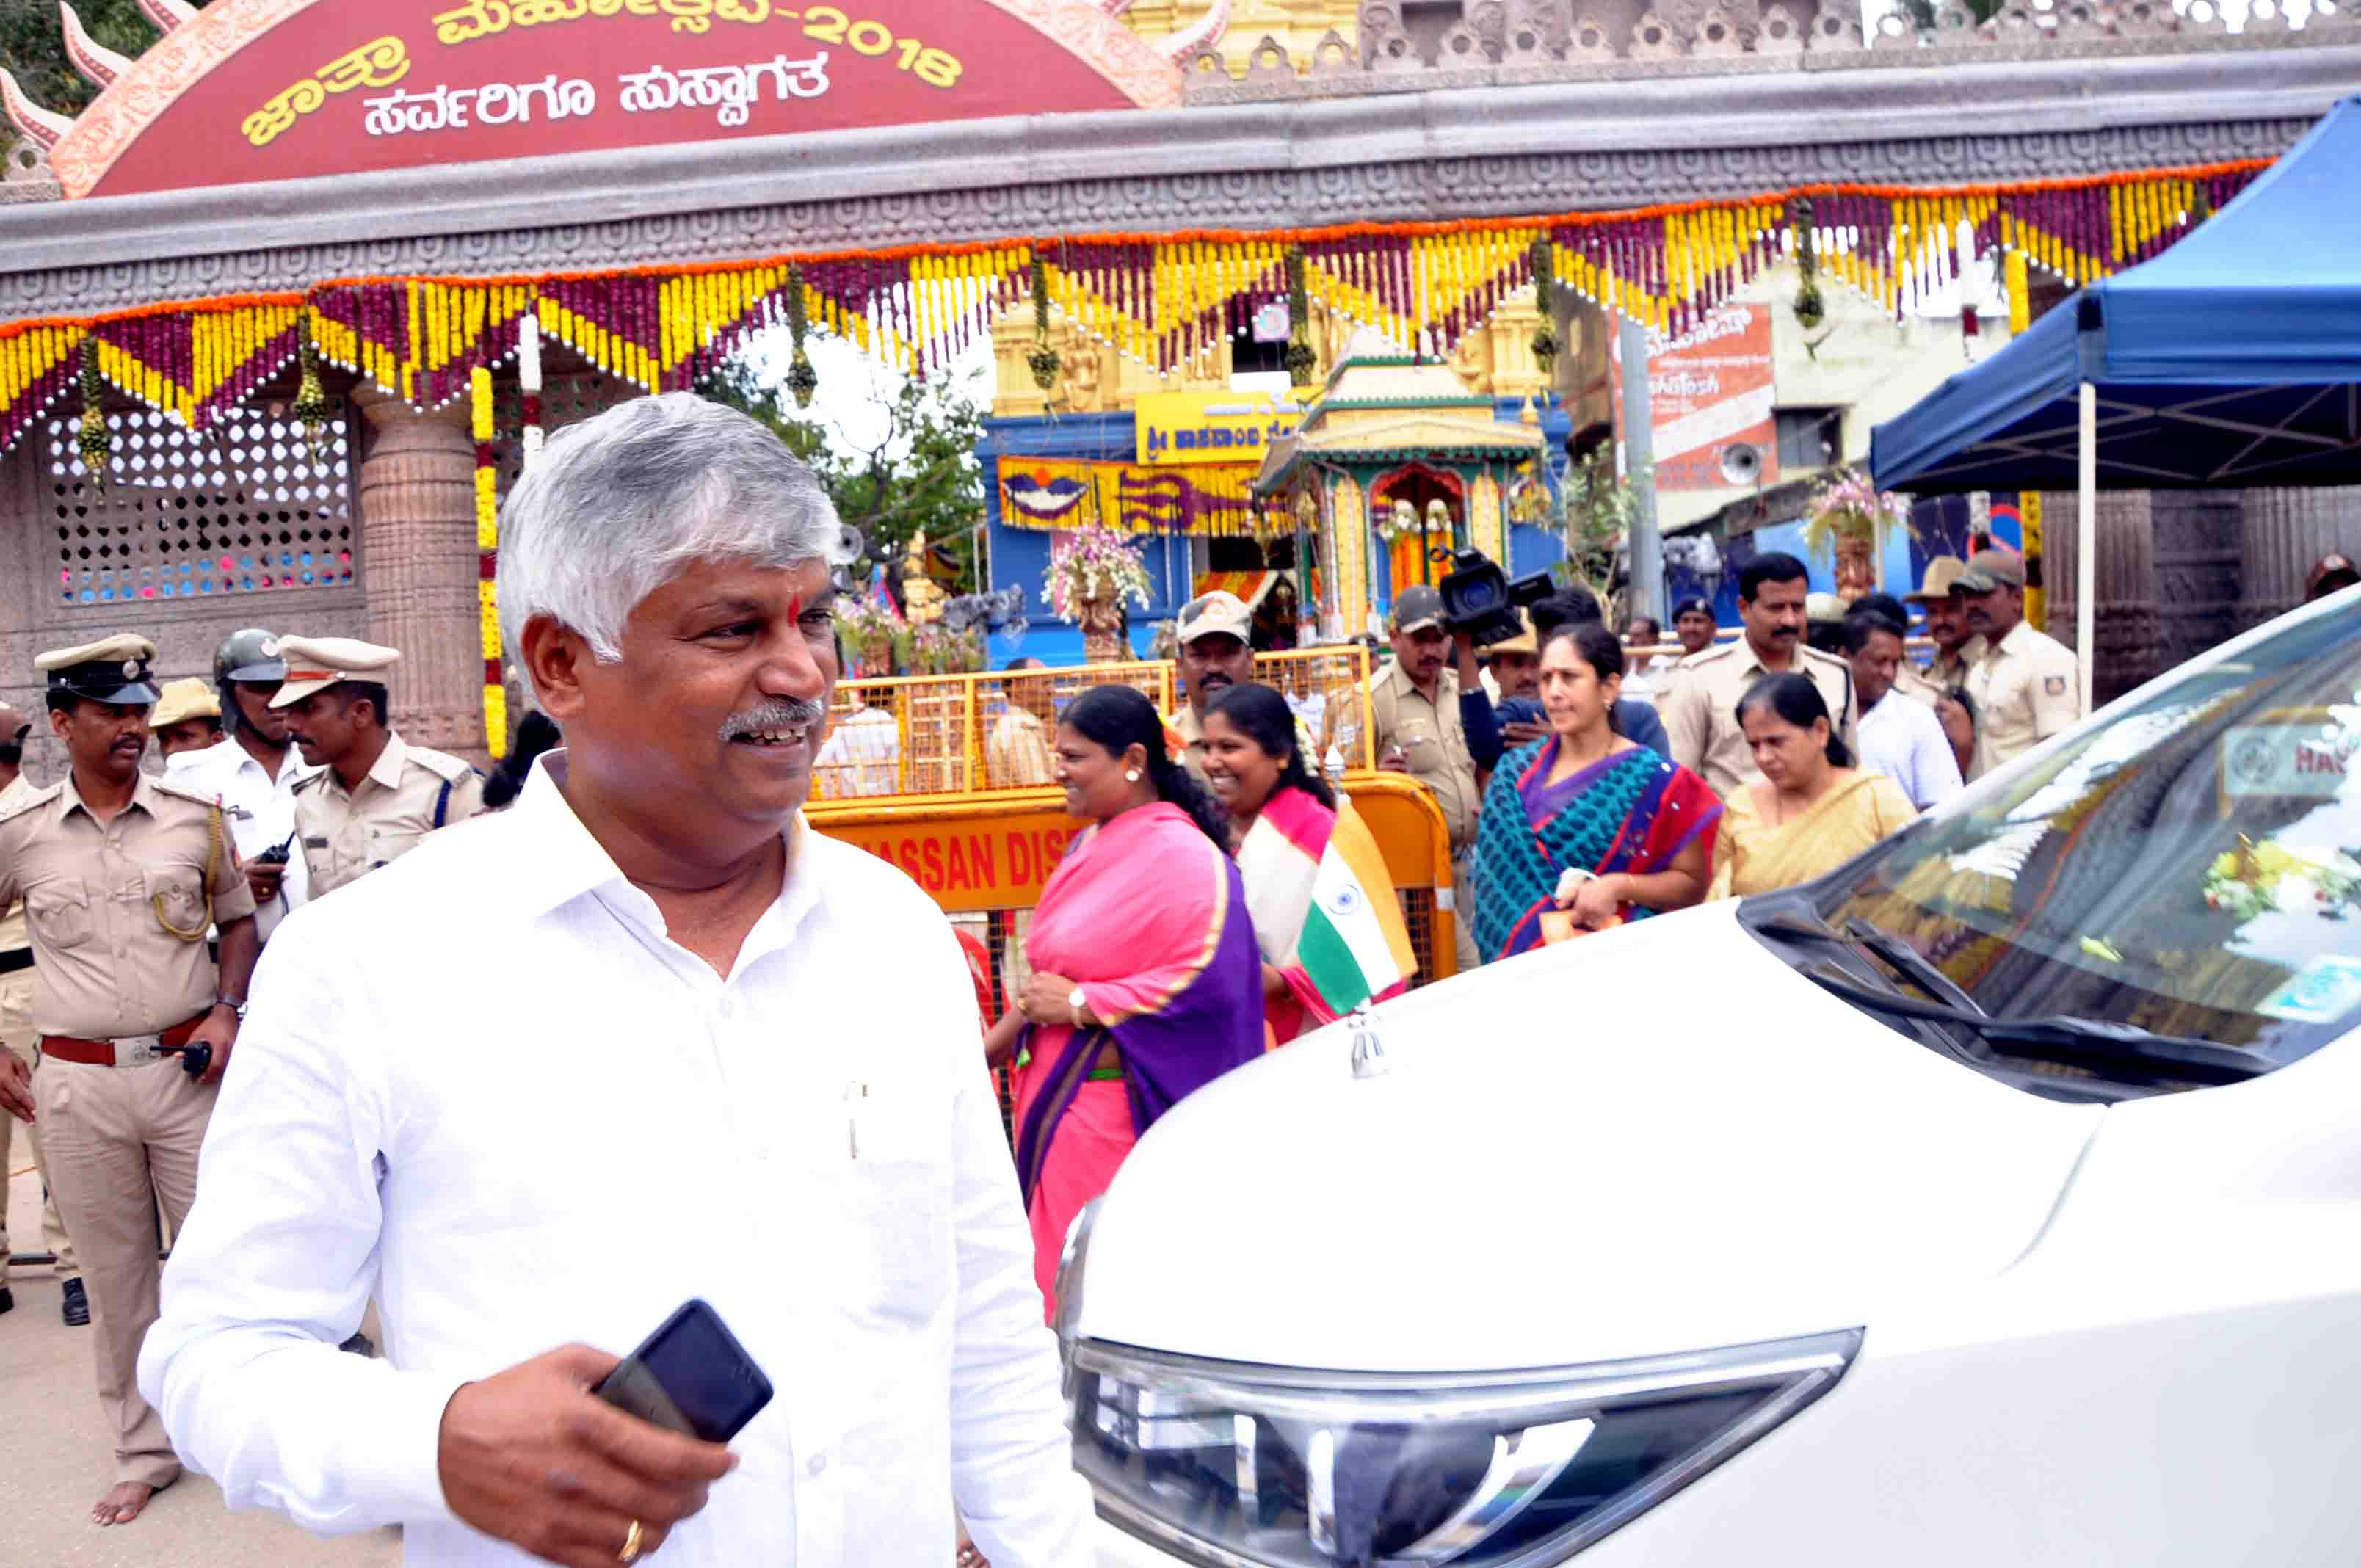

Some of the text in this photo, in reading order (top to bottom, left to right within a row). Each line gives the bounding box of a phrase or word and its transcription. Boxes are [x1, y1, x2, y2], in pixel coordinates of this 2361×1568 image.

[241, 35, 411, 146] ಜಾತ್ರಾ
[363, 51, 830, 136] ಸರ್ವರಿಗೂ ಸುಸ್ವಾಗತ
[861, 827, 1080, 892] SSAN DIS
